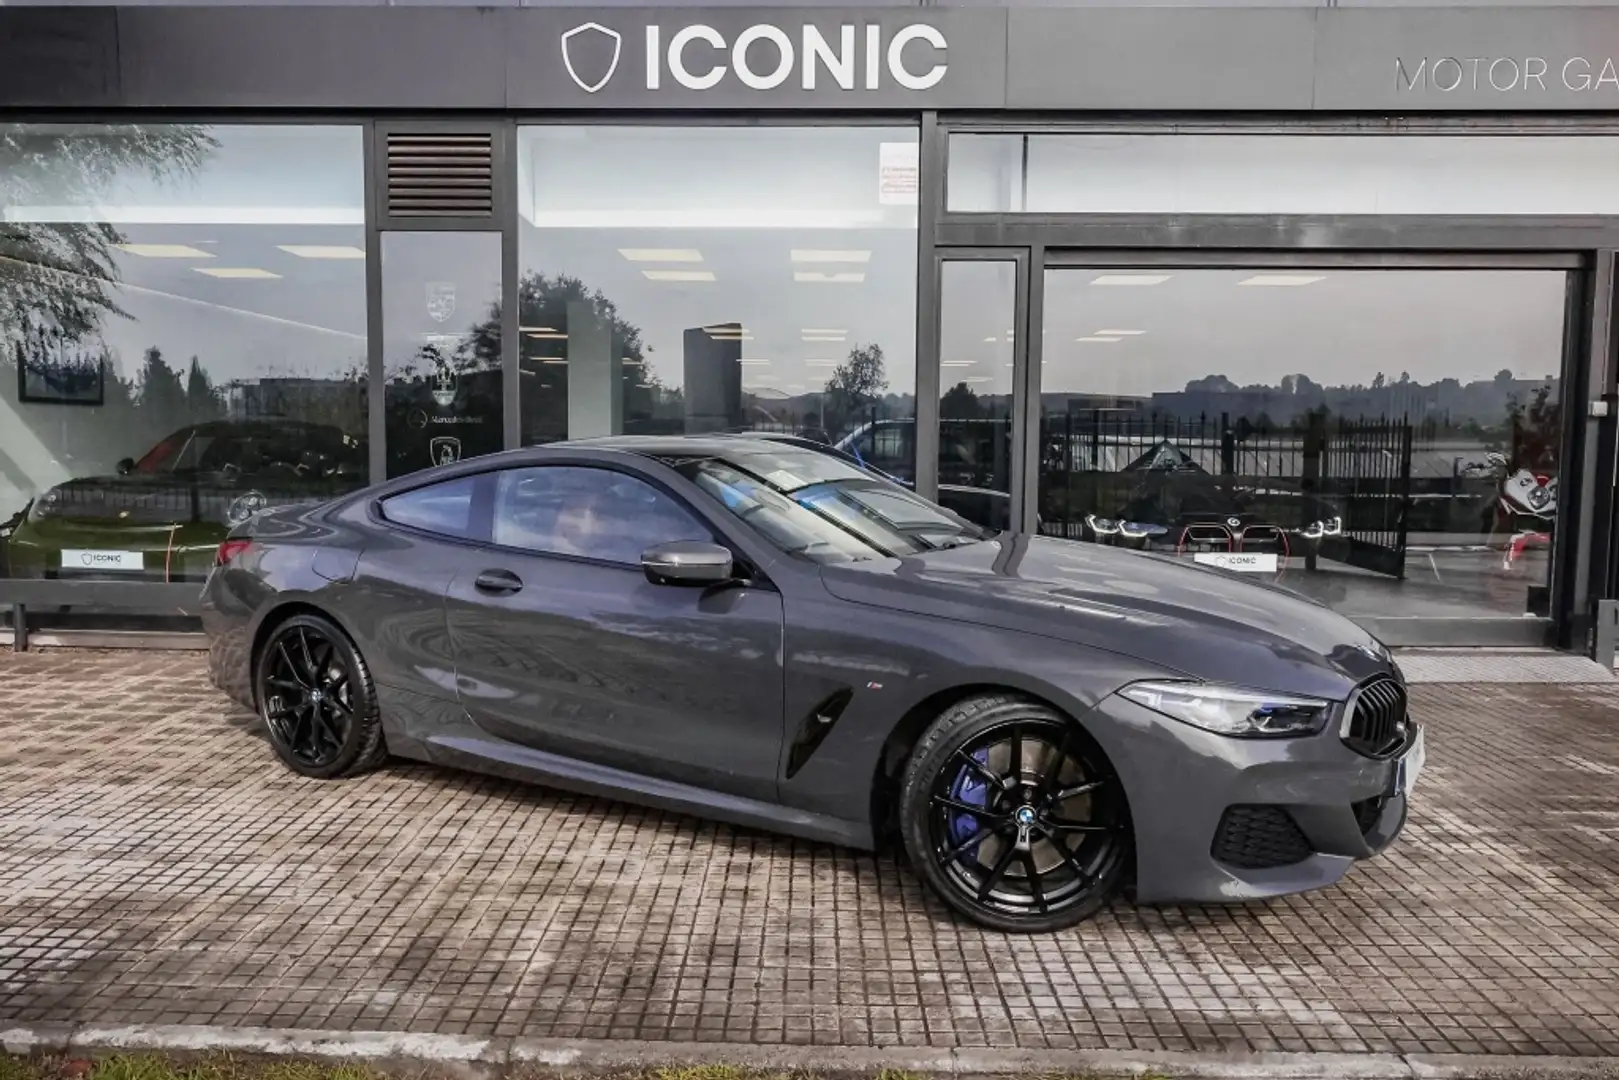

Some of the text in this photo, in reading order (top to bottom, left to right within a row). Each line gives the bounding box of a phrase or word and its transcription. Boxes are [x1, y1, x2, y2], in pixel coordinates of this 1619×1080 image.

[646, 24, 948, 90] ICONIC
[1395, 57, 1619, 91] MOTOR GA
[93, 554, 121, 562] ICONIC
